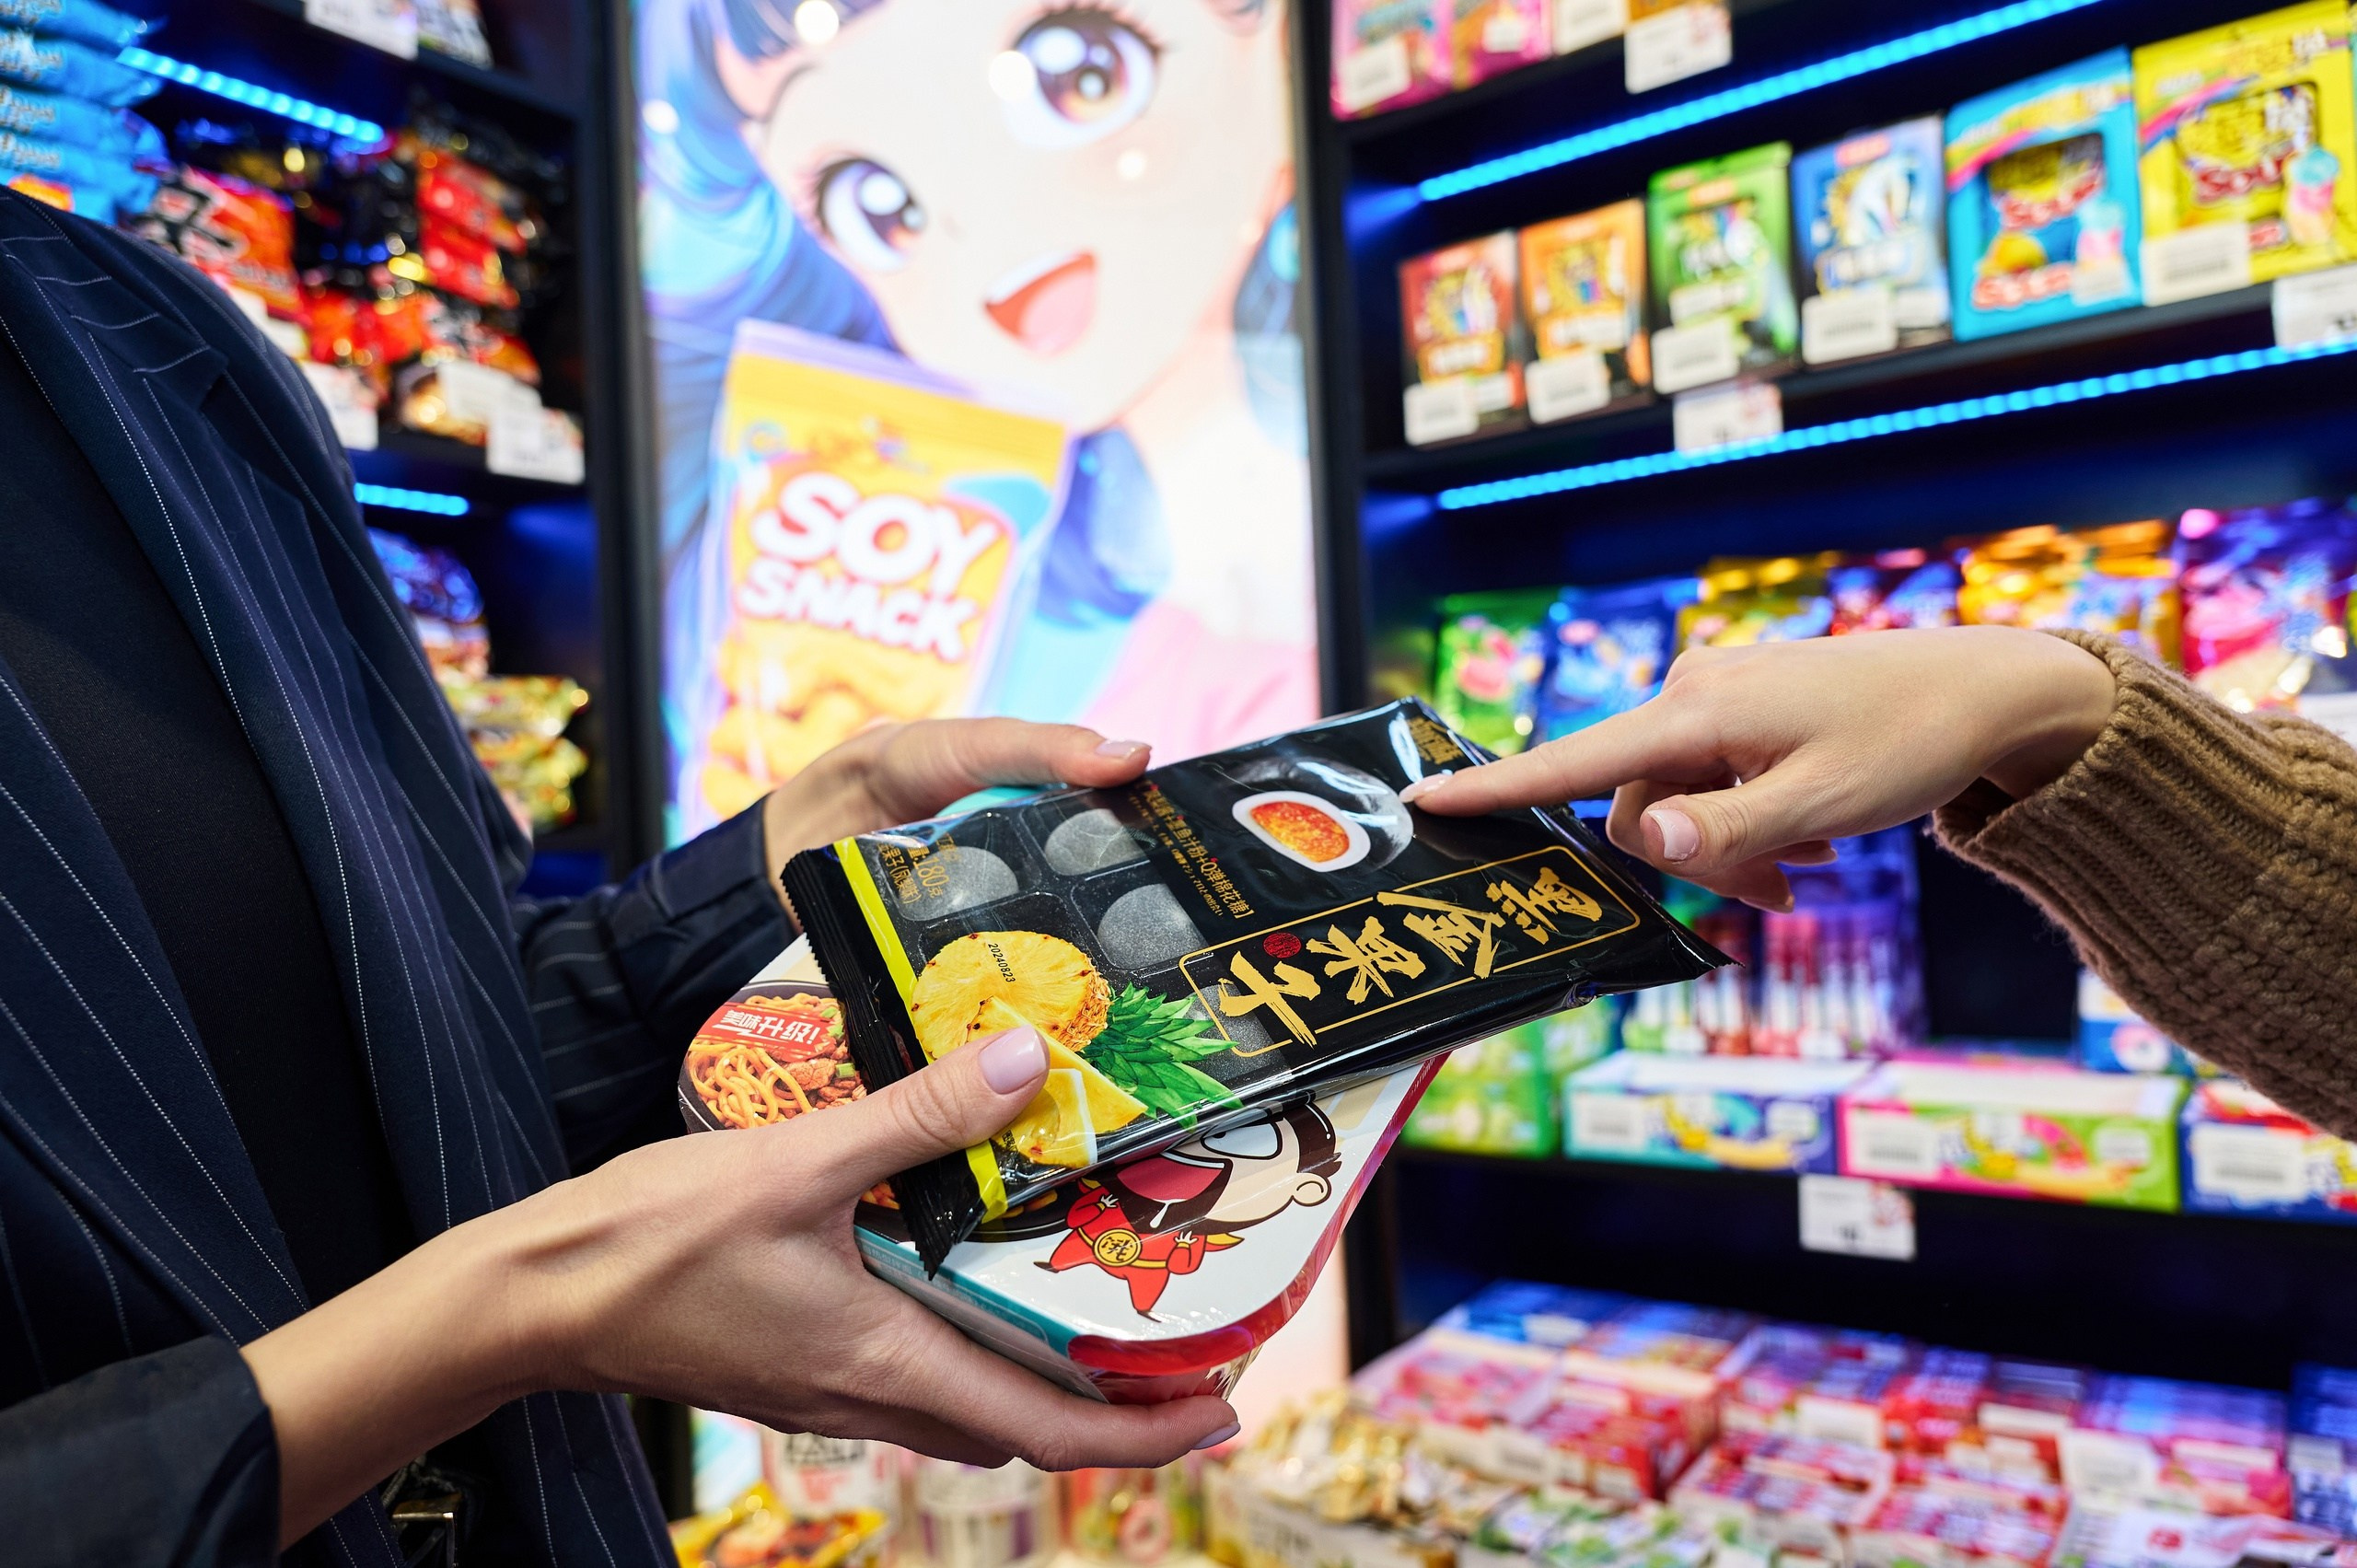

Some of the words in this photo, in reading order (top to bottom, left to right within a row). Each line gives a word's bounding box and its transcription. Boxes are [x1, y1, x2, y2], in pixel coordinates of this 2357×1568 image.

[750, 470, 1000, 598] SOY
[737, 560, 980, 663] SNACK
[987, 942, 1016, 983] 20240823
[1219, 866, 1603, 1049] 黑金果子
[720, 1009, 821, 1045] 美味升级!
